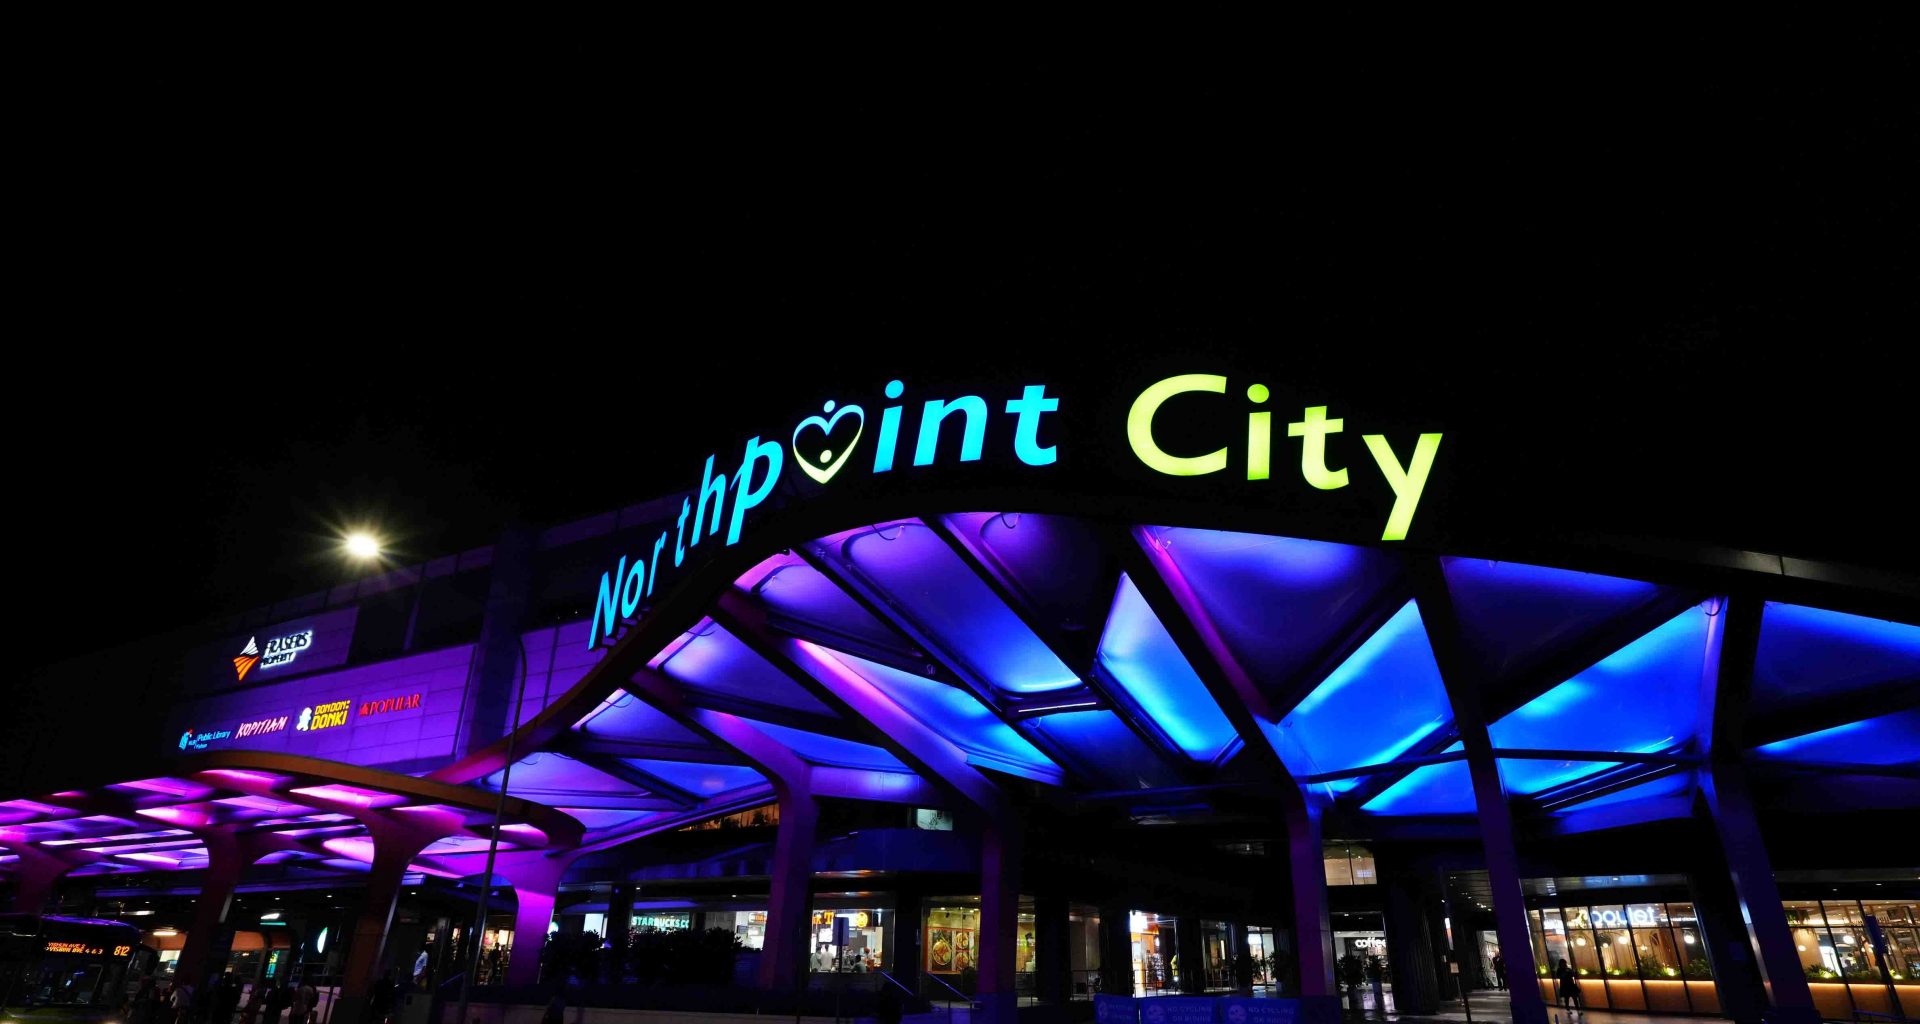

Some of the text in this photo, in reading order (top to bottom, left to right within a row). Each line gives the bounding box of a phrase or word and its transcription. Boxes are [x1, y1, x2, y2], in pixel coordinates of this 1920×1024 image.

[1126, 373, 1443, 541] City
[370, 693, 422, 716] POPULAR
[235, 716, 288, 739] KOPITIAM
[310, 710, 348, 731] DONKI
[631, 915, 680, 928] STARBUCKS
[113, 945, 130, 957] 812
